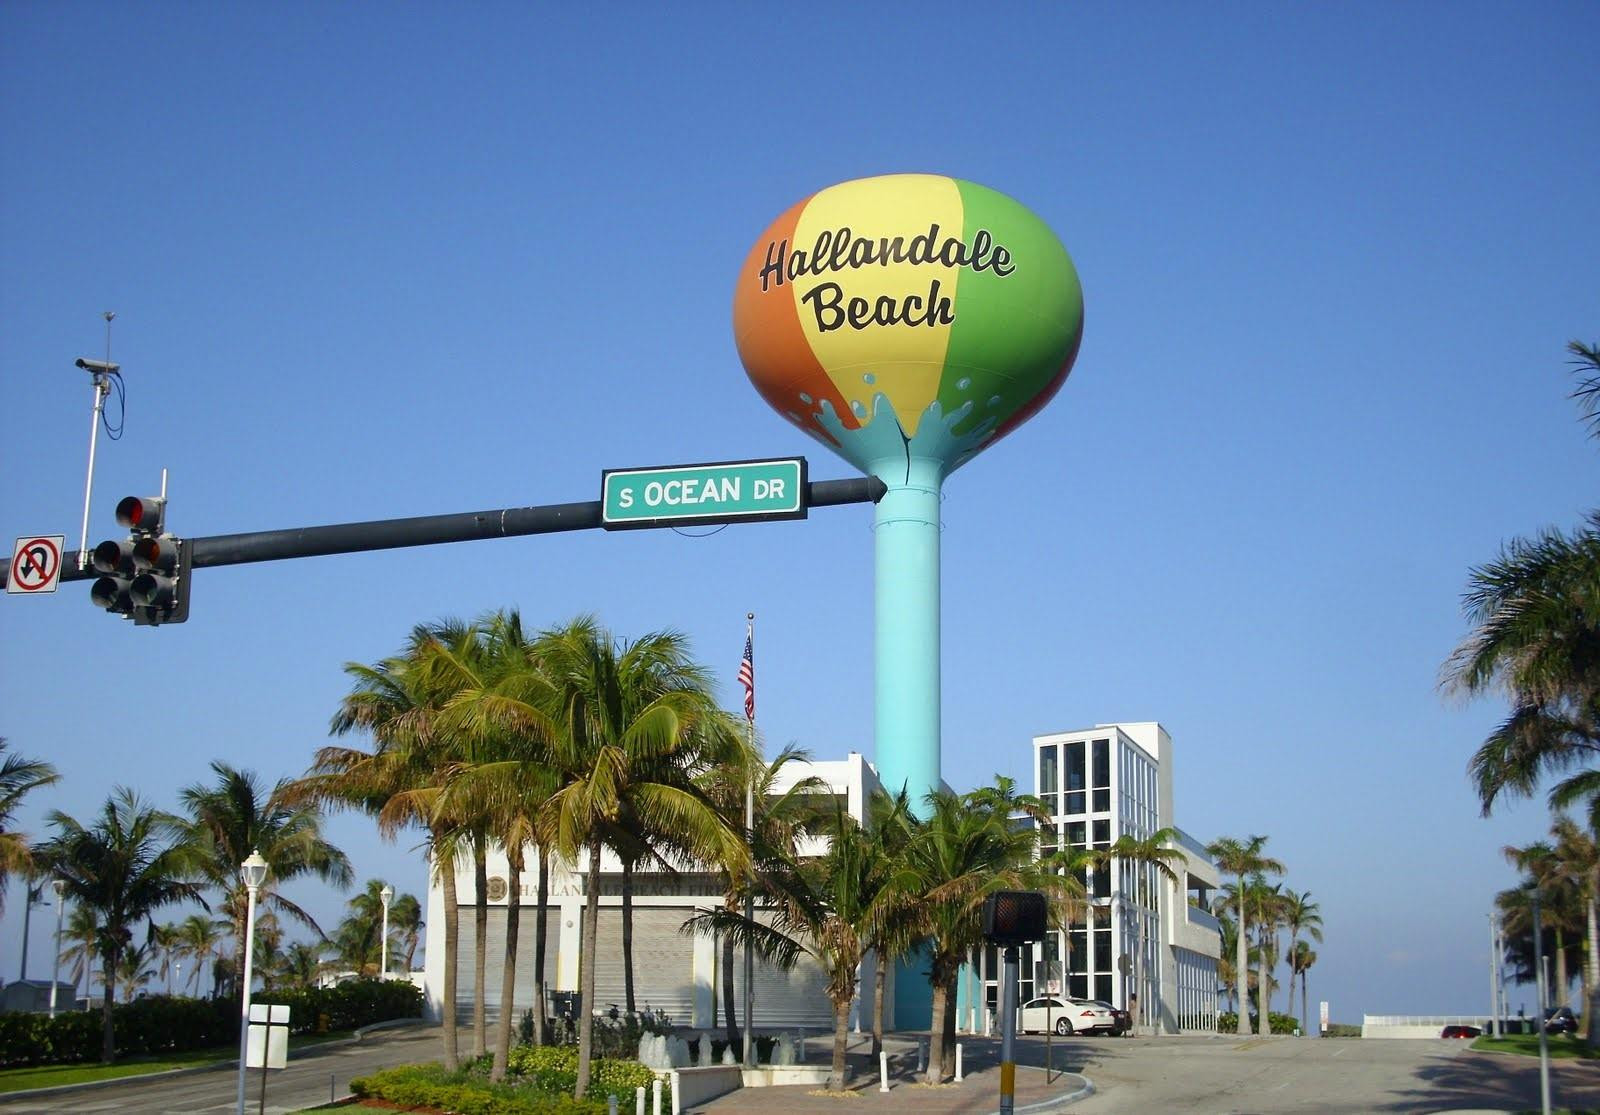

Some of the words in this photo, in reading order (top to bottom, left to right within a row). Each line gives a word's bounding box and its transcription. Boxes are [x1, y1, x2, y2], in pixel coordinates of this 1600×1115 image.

[759, 223, 1016, 292] Hallandale
[801, 279, 955, 333] Beach
[619, 488, 633, 508] S
[644, 477, 741, 506] OCEAN
[754, 479, 785, 500] DR
